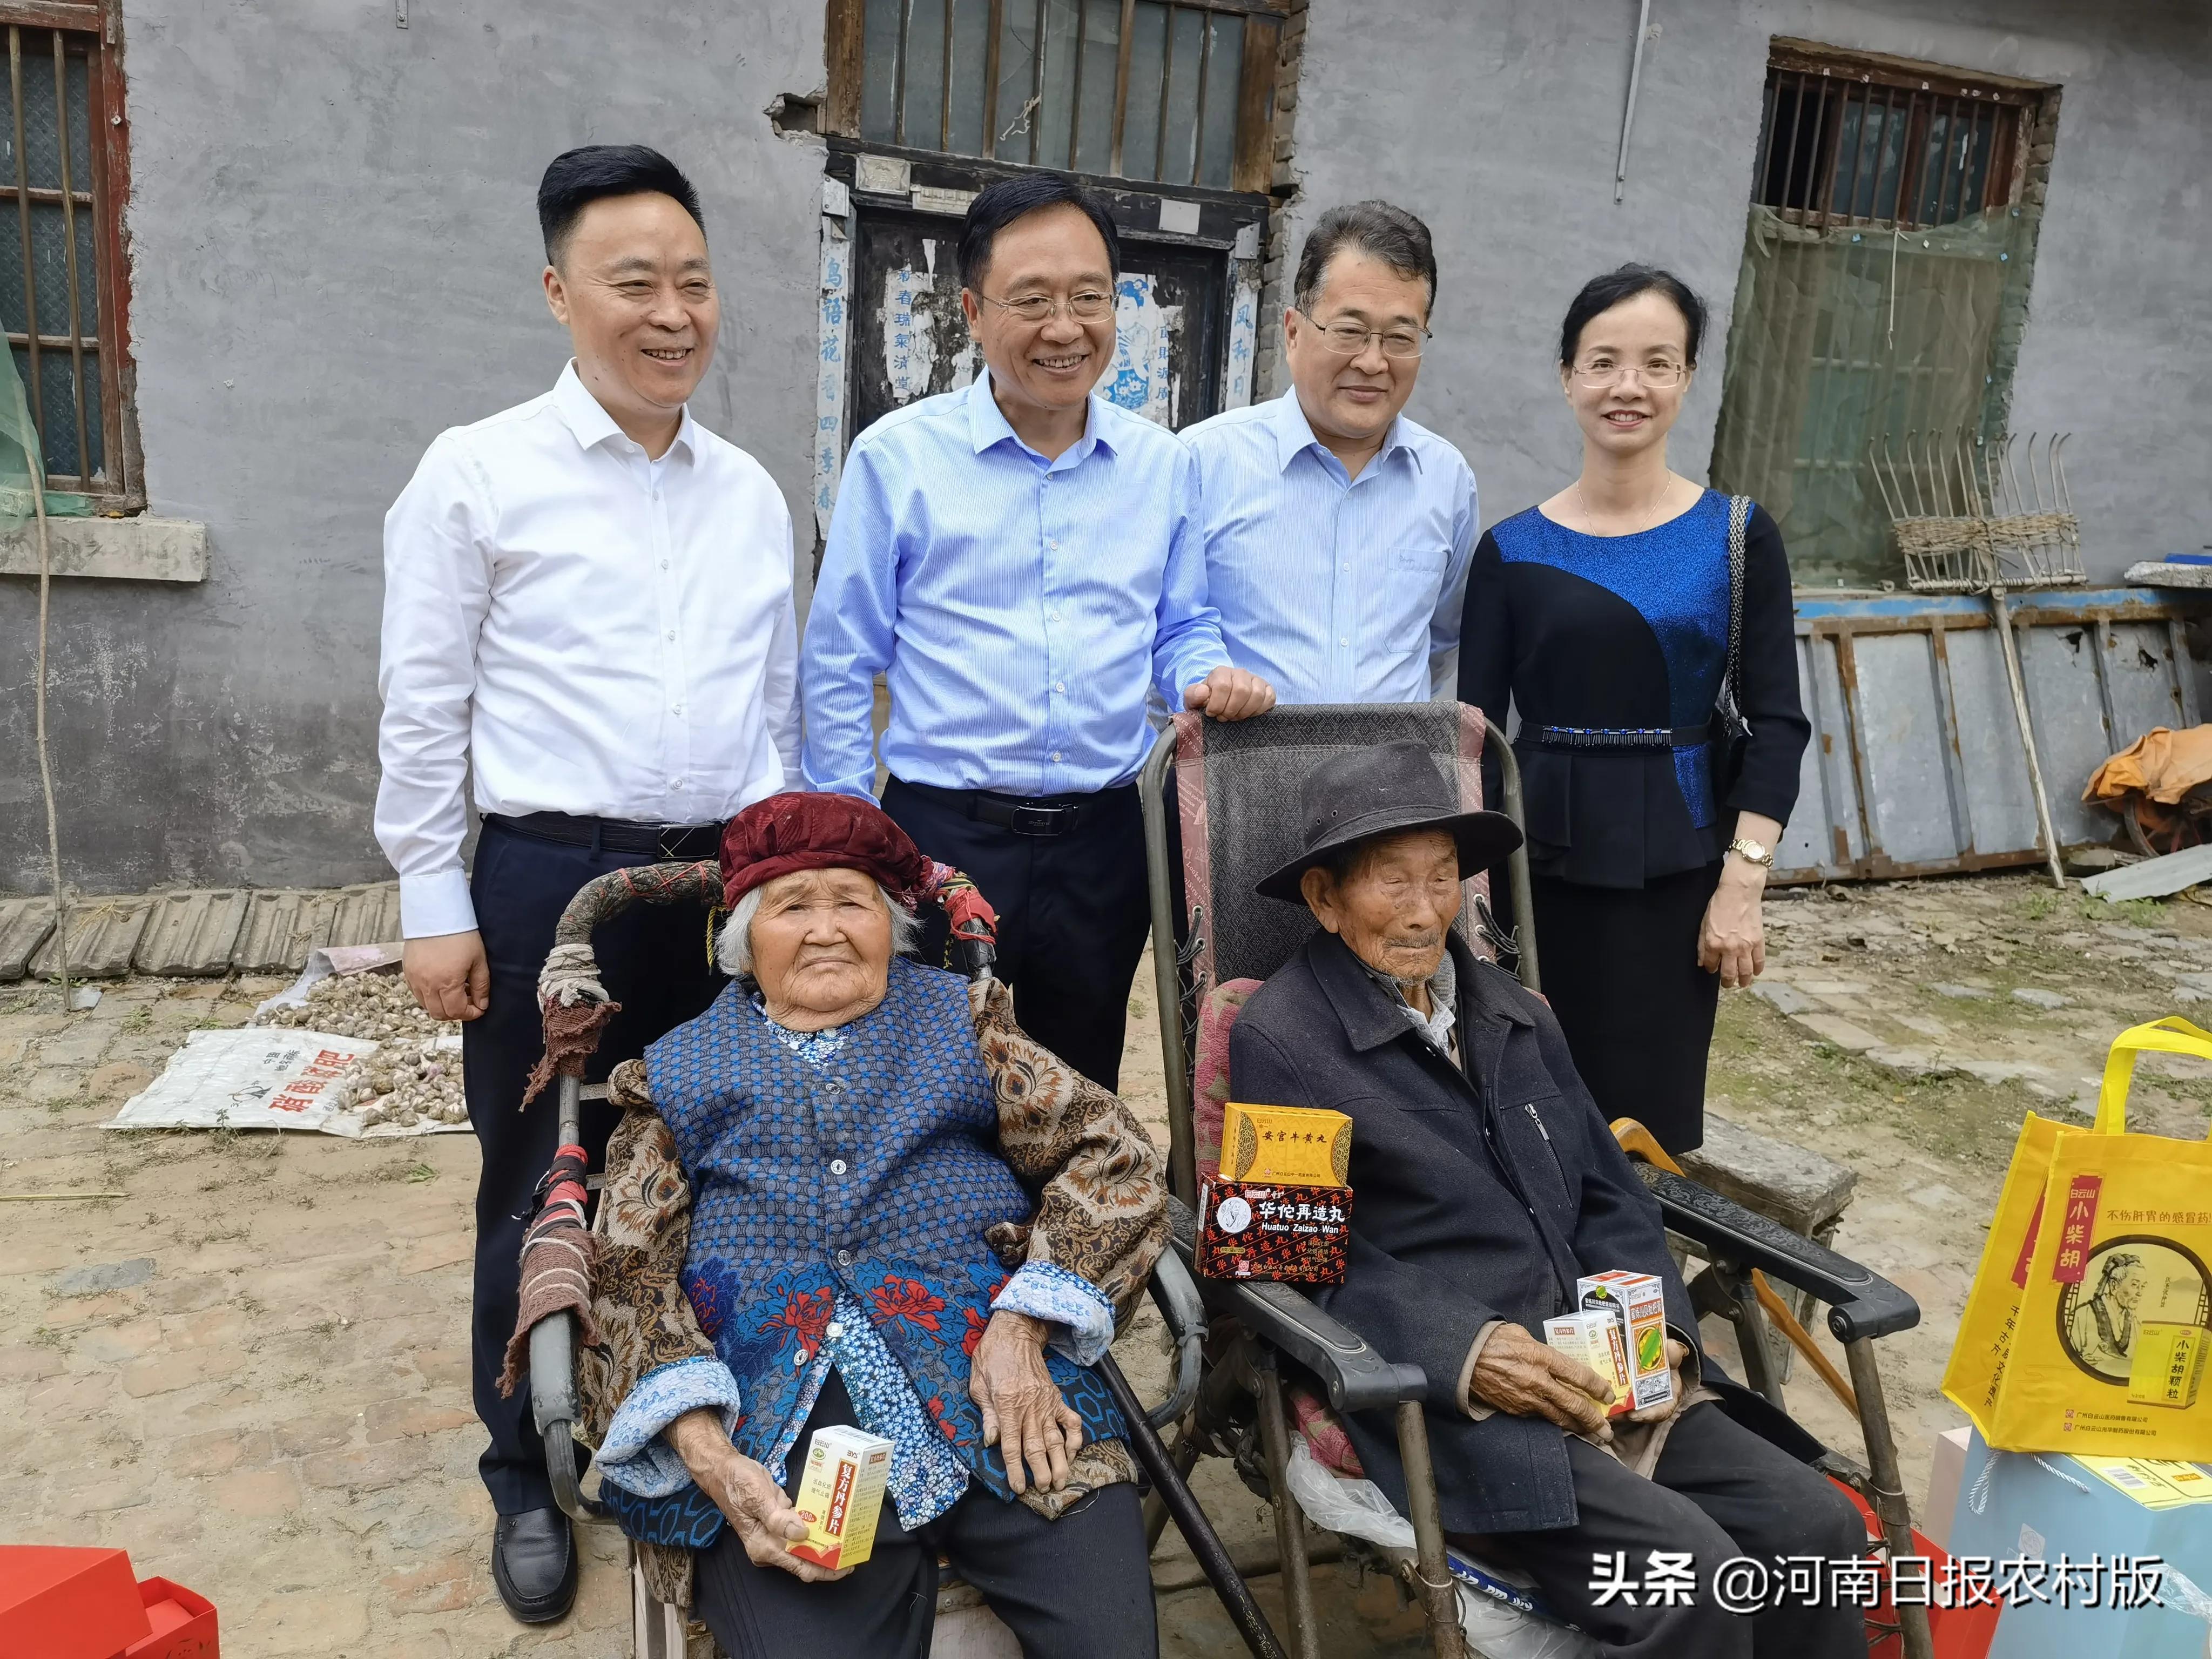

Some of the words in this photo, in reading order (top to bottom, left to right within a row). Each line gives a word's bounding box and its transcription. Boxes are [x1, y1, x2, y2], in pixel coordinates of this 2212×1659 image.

[816, 257, 844, 510] 鸟语花香四季春
[1263, 1130, 1327, 1144] 安宫牛黄丸
[1245, 1190, 1267, 1199] 白云山
[2070, 1189, 2096, 1199] 白云山
[1259, 1201, 1345, 1222] 华佗再造丸
[1262, 1222, 1289, 1232] Huatuo
[1292, 1223, 1318, 1233] Zaizao
[1322, 1225, 1339, 1234] Wan
[2060, 1201, 2089, 1269] 小柴胡
[1991, 1305, 2020, 1356] 千年古方
[2166, 1339, 2189, 1400] 小柴胡颗粒
[814, 1439, 831, 1449] 白云山
[827, 1463, 853, 1535] 复方丹参片
